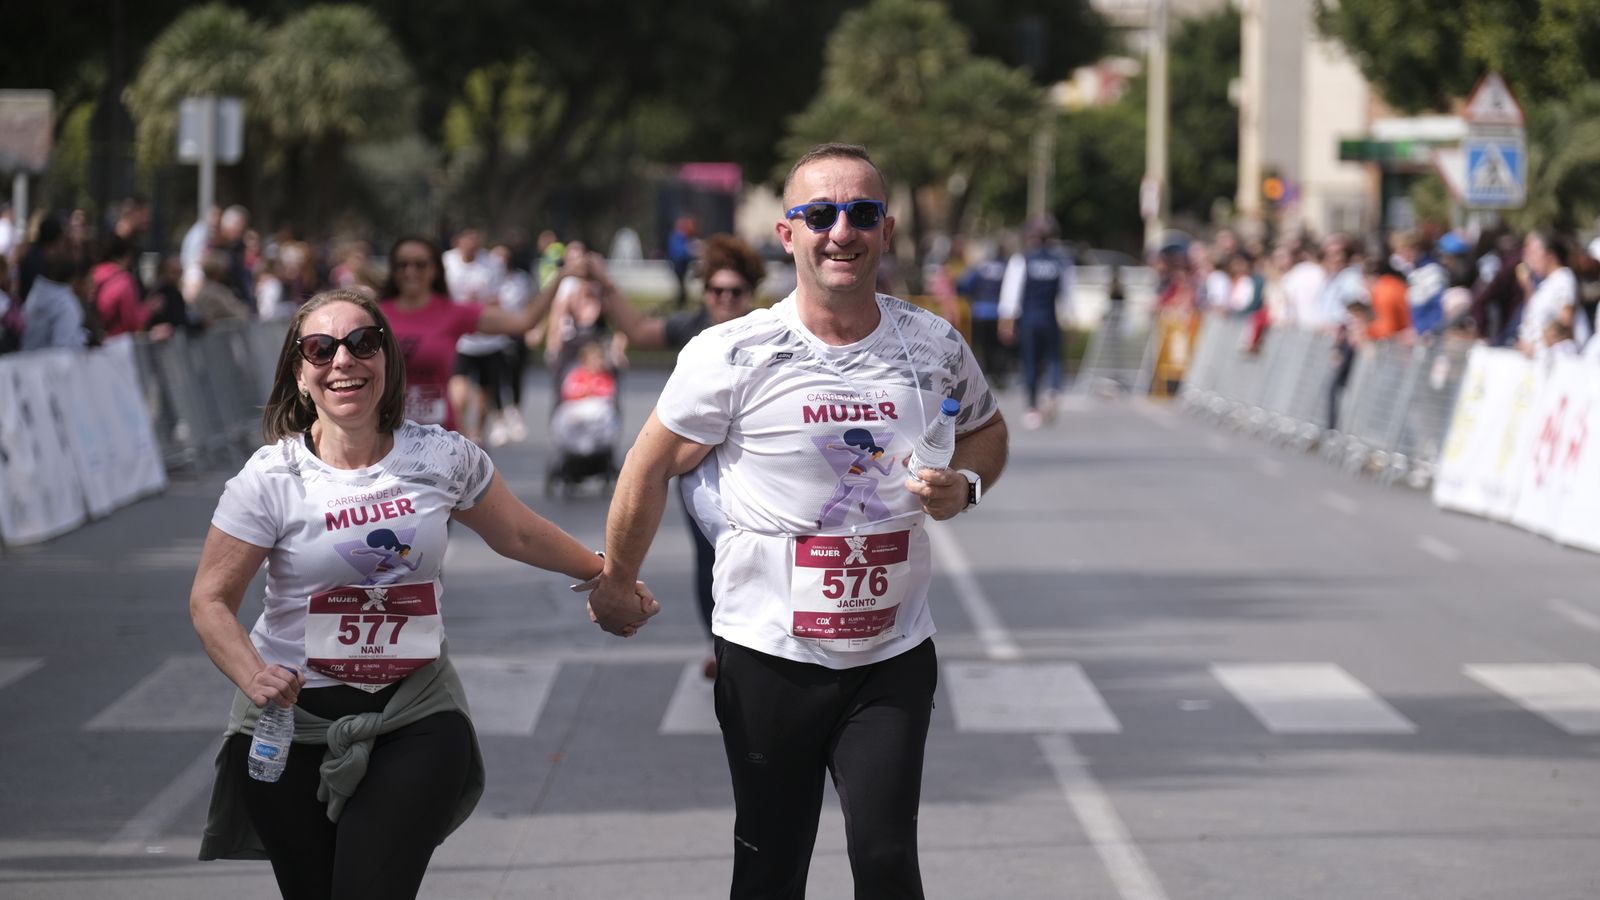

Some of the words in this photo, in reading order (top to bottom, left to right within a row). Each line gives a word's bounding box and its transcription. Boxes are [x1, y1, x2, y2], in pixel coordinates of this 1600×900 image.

[807, 393, 856, 402] CARRERA
[875, 389, 889, 399] LA
[803, 402, 898, 423] MUJER
[327, 494, 375, 508] CARRERA
[376, 489, 390, 500] DE
[390, 487, 403, 497] LA
[325, 497, 416, 531] MUJER
[822, 567, 888, 599] 576
[837, 598, 877, 608] JACINTO
[338, 615, 408, 645] 577
[361, 645, 384, 654] NANI
